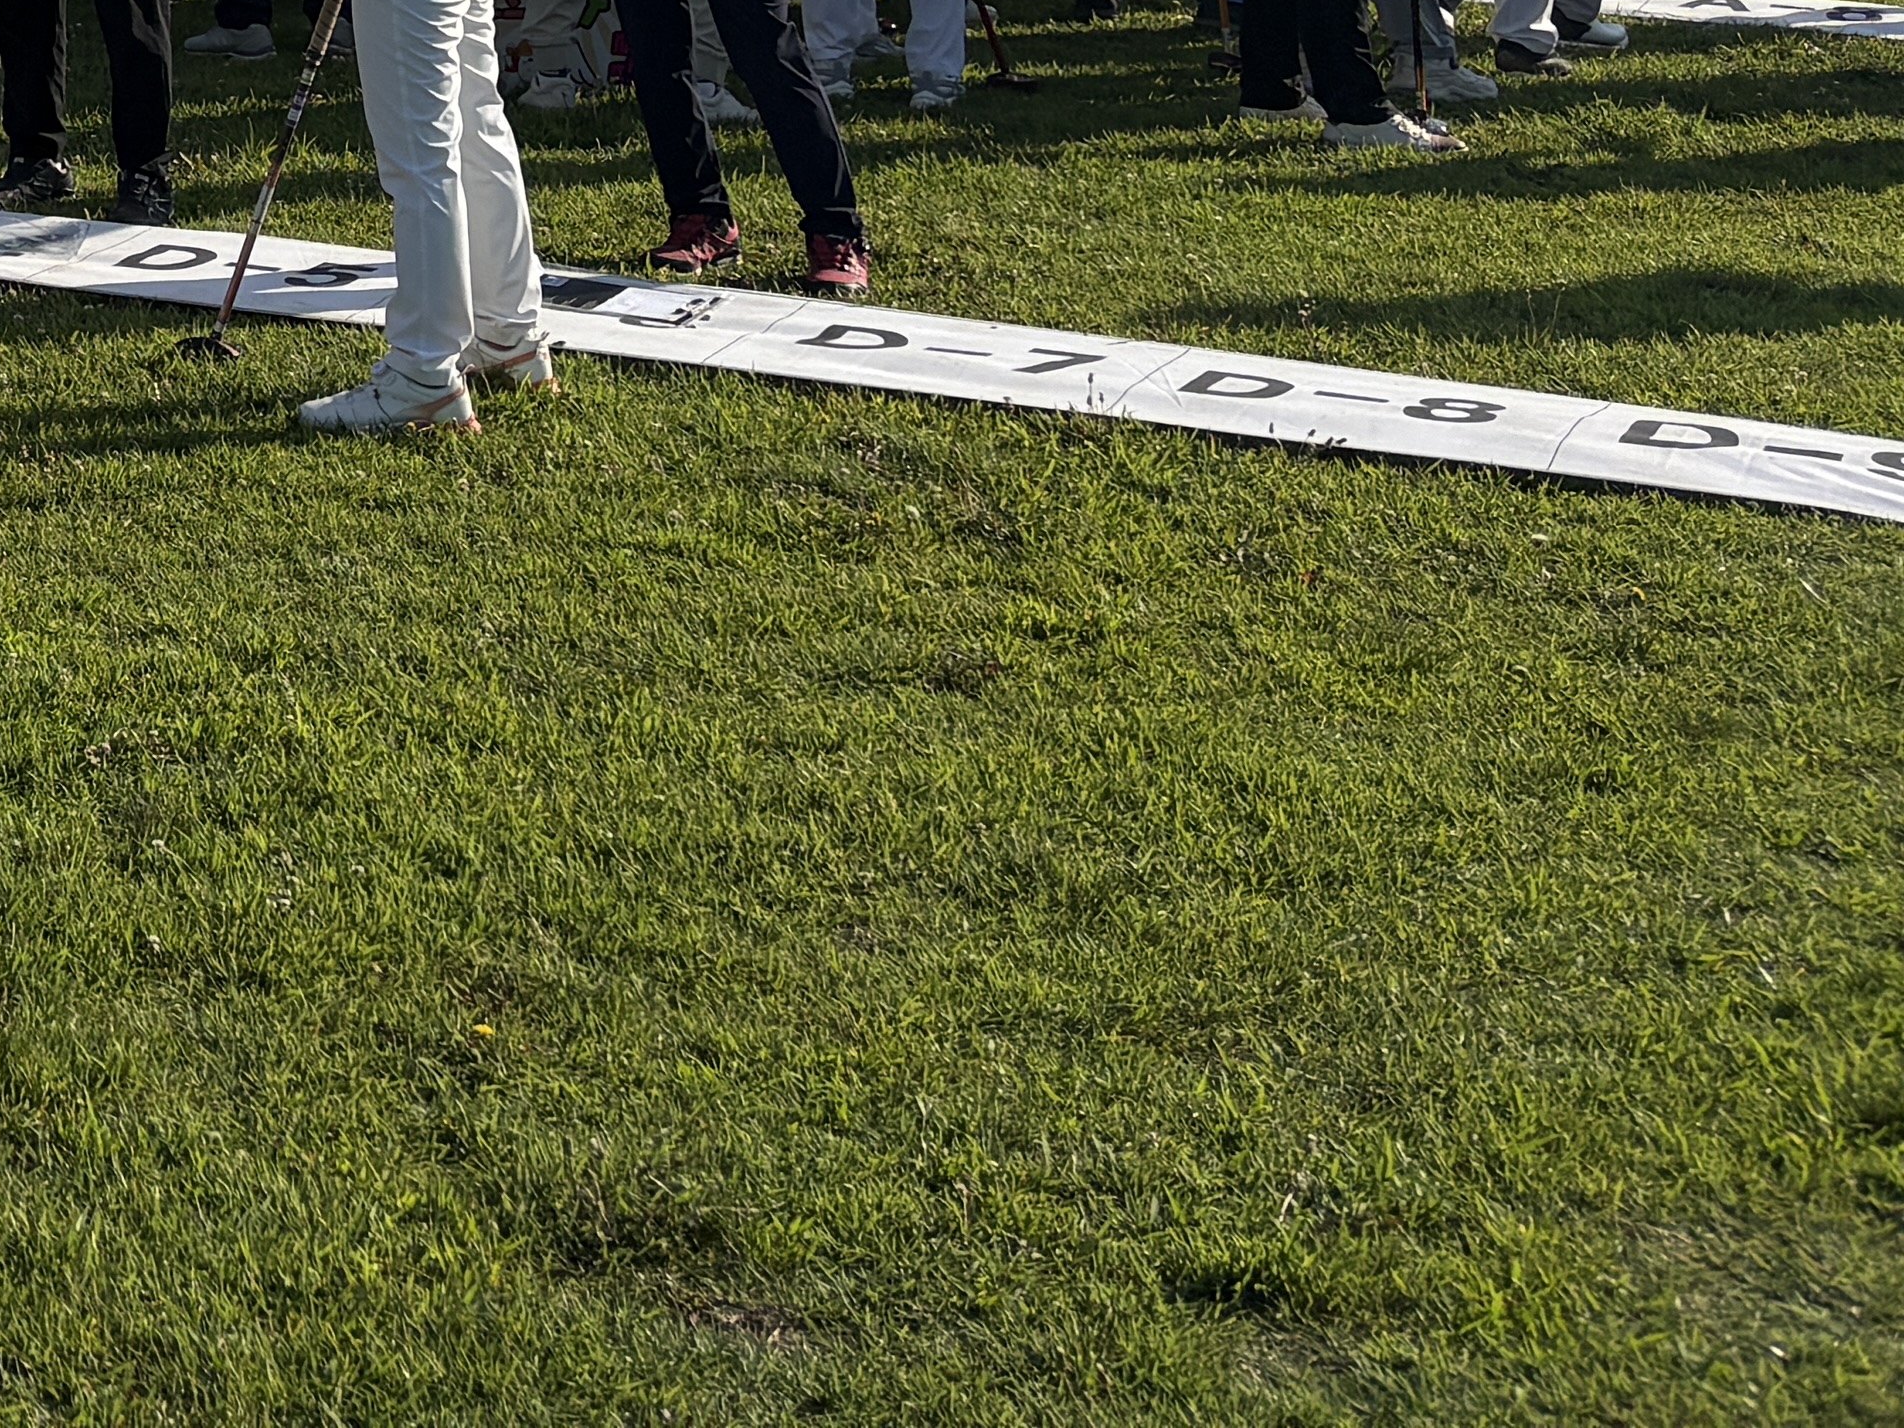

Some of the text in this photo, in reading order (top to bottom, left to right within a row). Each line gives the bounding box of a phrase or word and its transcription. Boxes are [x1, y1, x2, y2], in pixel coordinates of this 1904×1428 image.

[112, 243, 379, 288] D-5
[794, 323, 1108, 375] D-7
[1177, 369, 1508, 424] D-8
